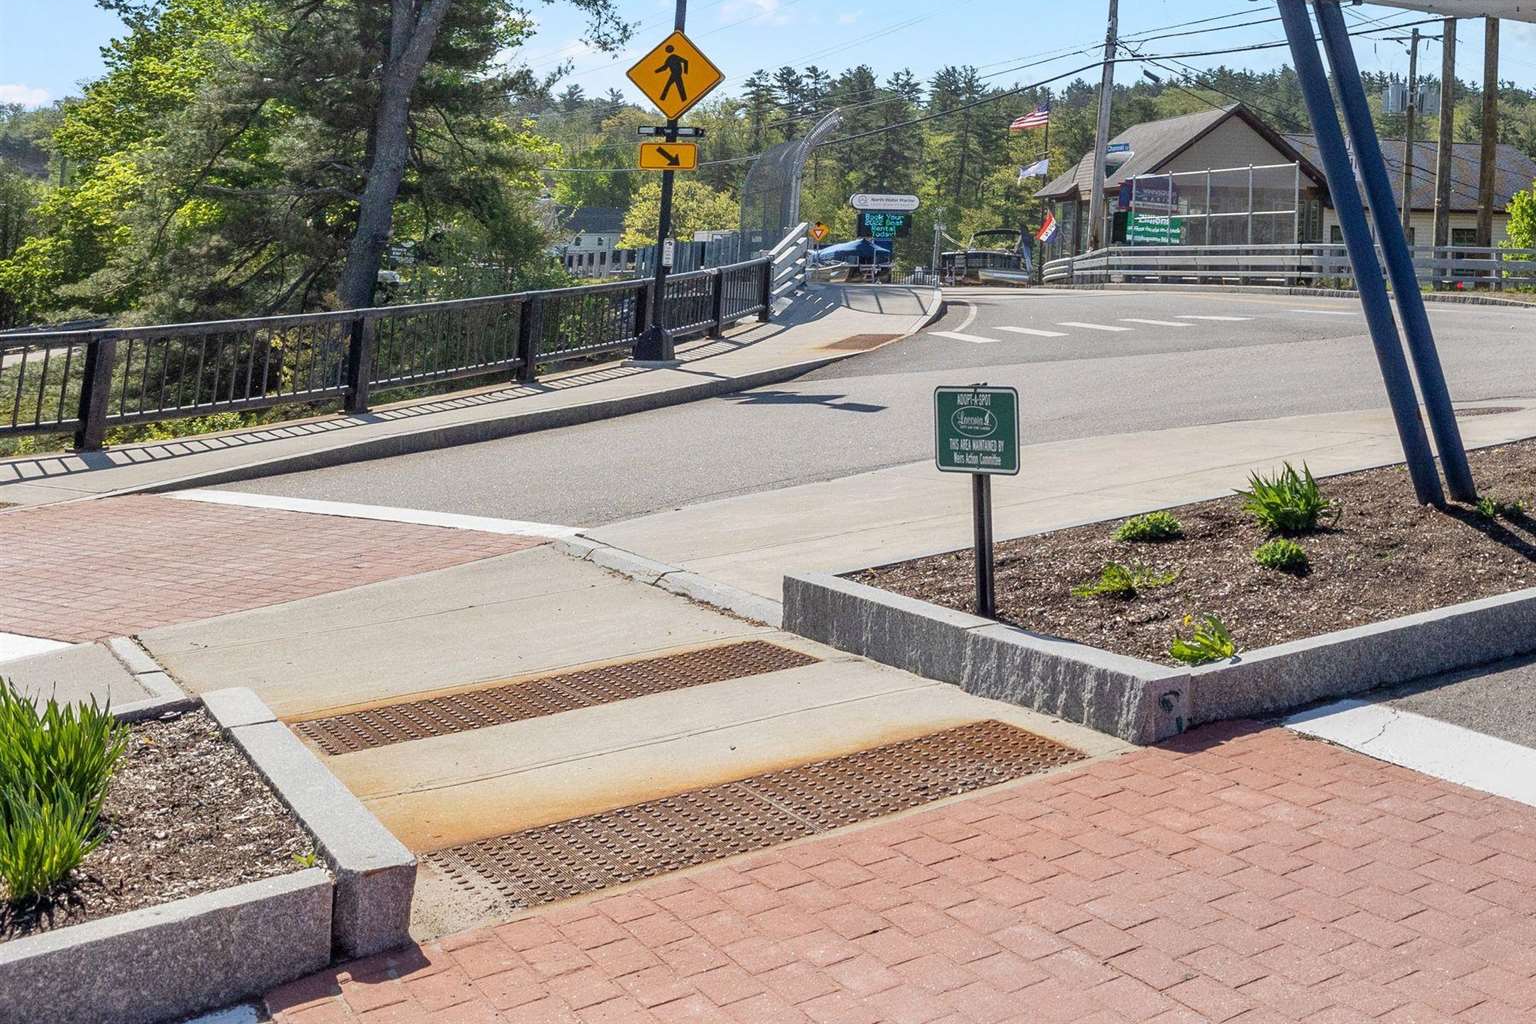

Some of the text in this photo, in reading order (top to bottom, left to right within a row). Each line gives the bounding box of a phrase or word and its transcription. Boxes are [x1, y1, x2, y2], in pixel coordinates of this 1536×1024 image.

[957, 394, 991, 406] ADOPT-A-SPOT
[949, 438, 1004, 452] THIS AREA MAINTAINED BY
[953, 451, 1001, 465] Weirs Action Committee
